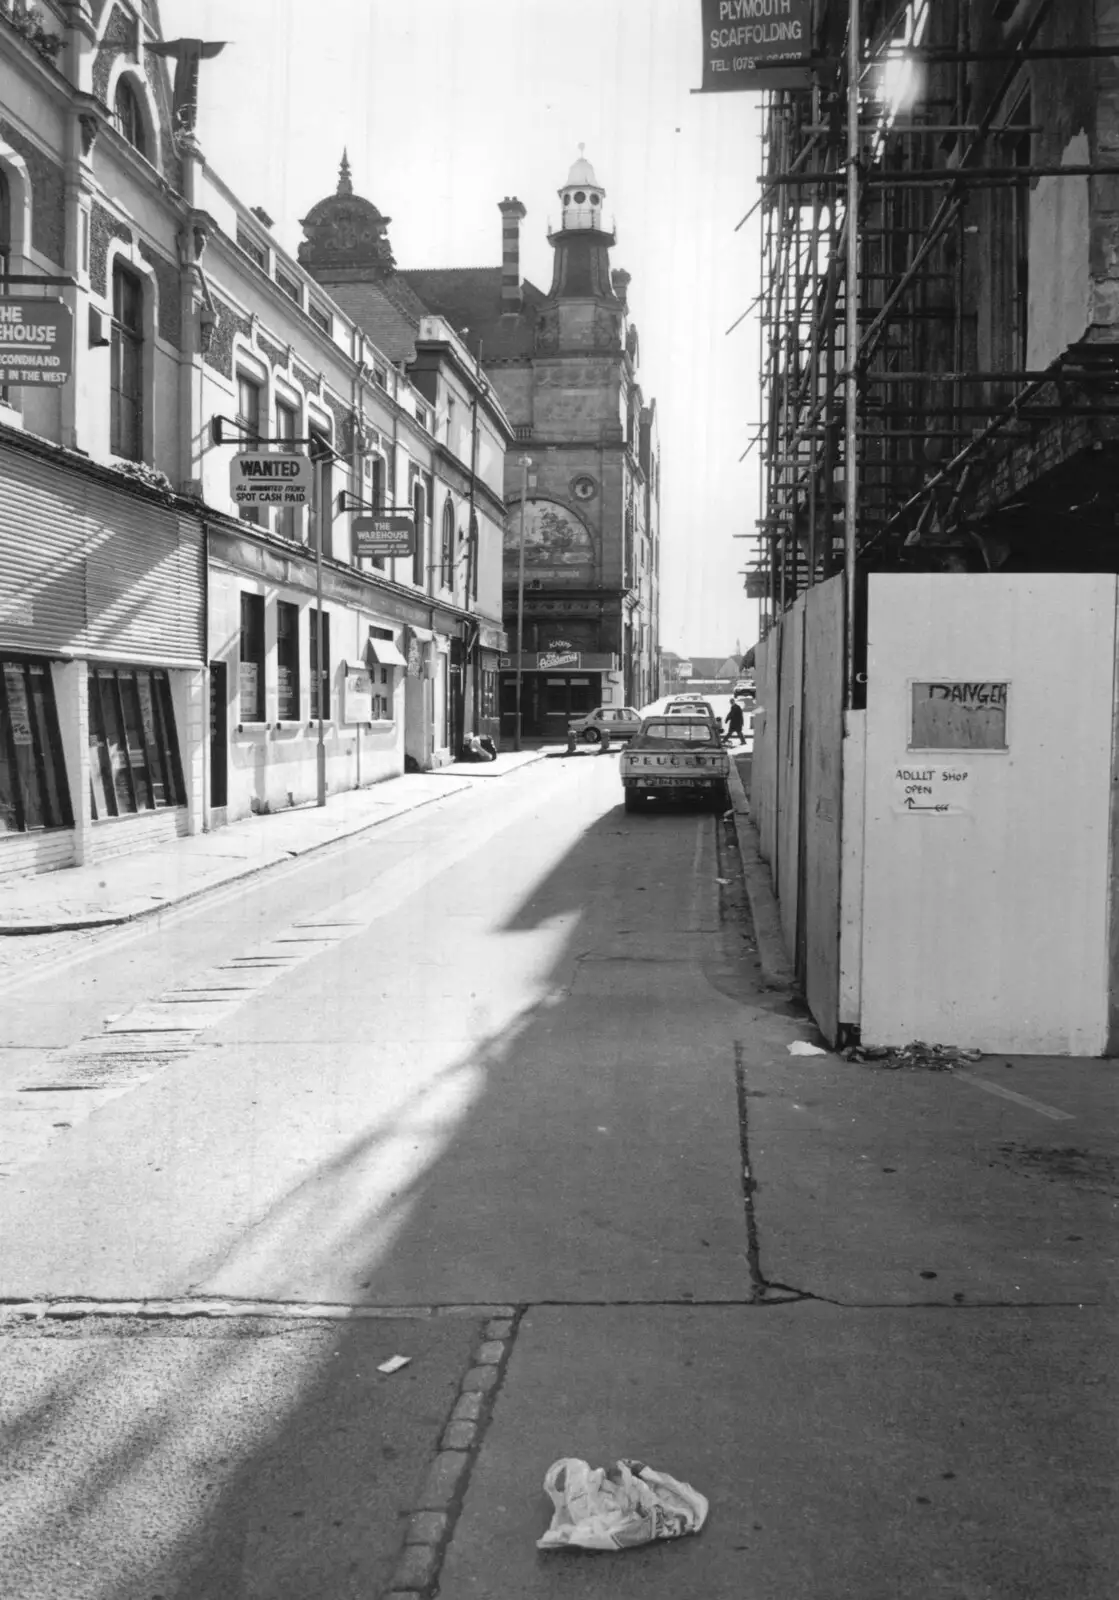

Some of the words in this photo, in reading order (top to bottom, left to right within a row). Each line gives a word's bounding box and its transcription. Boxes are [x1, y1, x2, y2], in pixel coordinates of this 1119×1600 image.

[720, 0, 791, 21] PLYMOUTH
[710, 16, 803, 49] SCAFFOLDING
[0, 354, 61, 367] CONDHAND
[8, 369, 19, 380] IN
[20, 370, 41, 382] THE
[42, 371, 68, 383] WEST
[239, 460, 301, 477] WANTED
[235, 492, 256, 502] SPOT
[259, 492, 282, 502] CASH
[284, 493, 306, 502] PAID
[374, 522, 392, 531] THE
[356, 530, 410, 541] WAREHOUSE
[928, 682, 1008, 704] DANGER
[629, 755, 718, 768] PEUGEOT
[894, 769, 937, 782] ADULT
[941, 771, 969, 782] SHOP
[904, 784, 933, 795] OPEN
